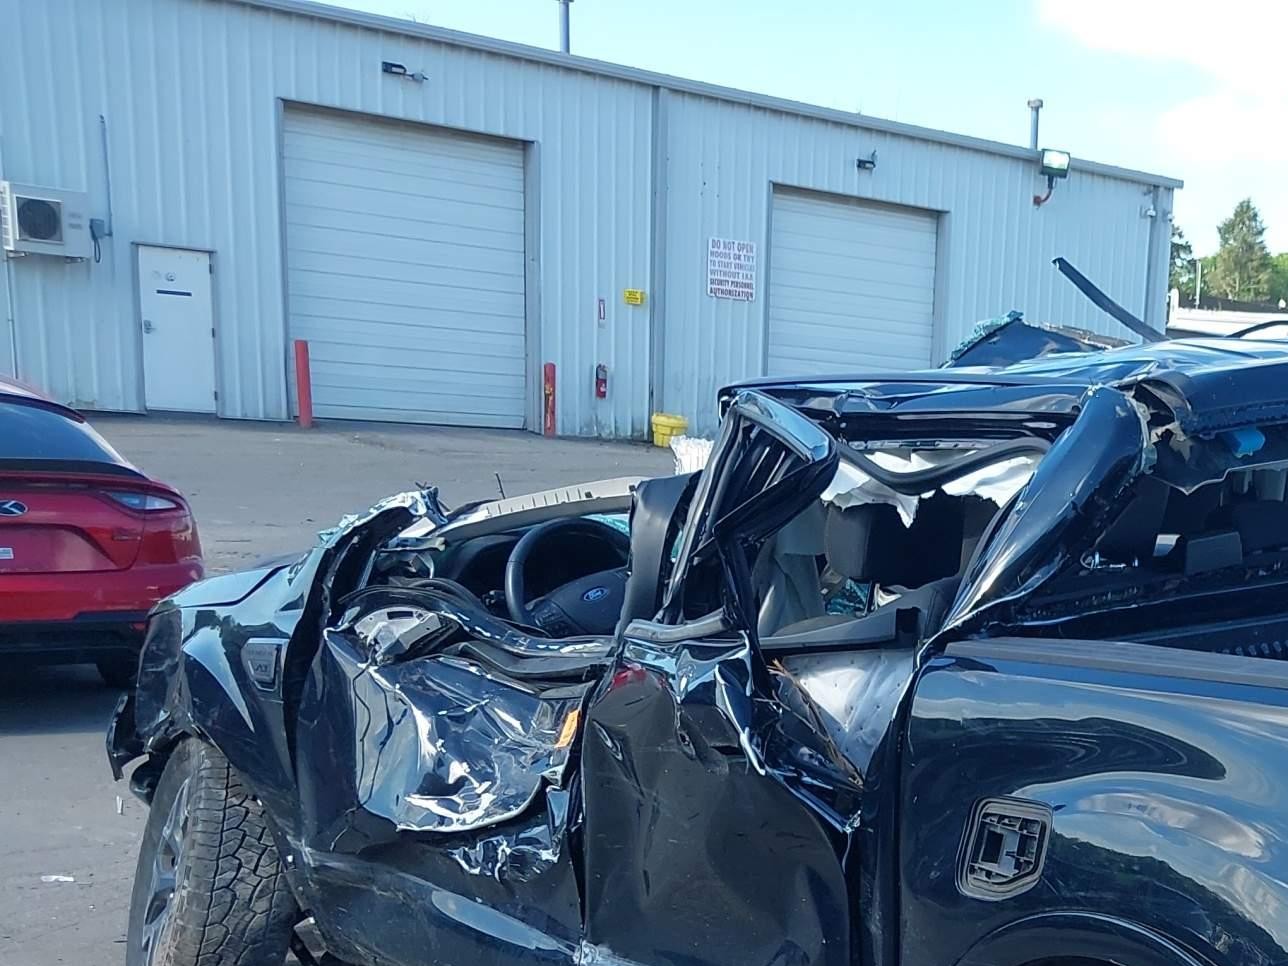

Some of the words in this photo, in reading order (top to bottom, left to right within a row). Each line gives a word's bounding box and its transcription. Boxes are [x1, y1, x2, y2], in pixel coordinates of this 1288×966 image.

[711, 239, 721, 249] DO
[722, 240, 735, 251] NOT
[737, 242, 754, 253] OPEN
[710, 250, 731, 260] HOODS
[733, 253, 741, 261] OR
[743, 254, 754, 263] TRY
[717, 260, 732, 269] START
[710, 270, 740, 279] WITHOUT
[710, 279, 730, 287] SECURITY
[731, 281, 753, 289] PERSONNEL
[710, 287, 753, 298] AUTHORIZATION
